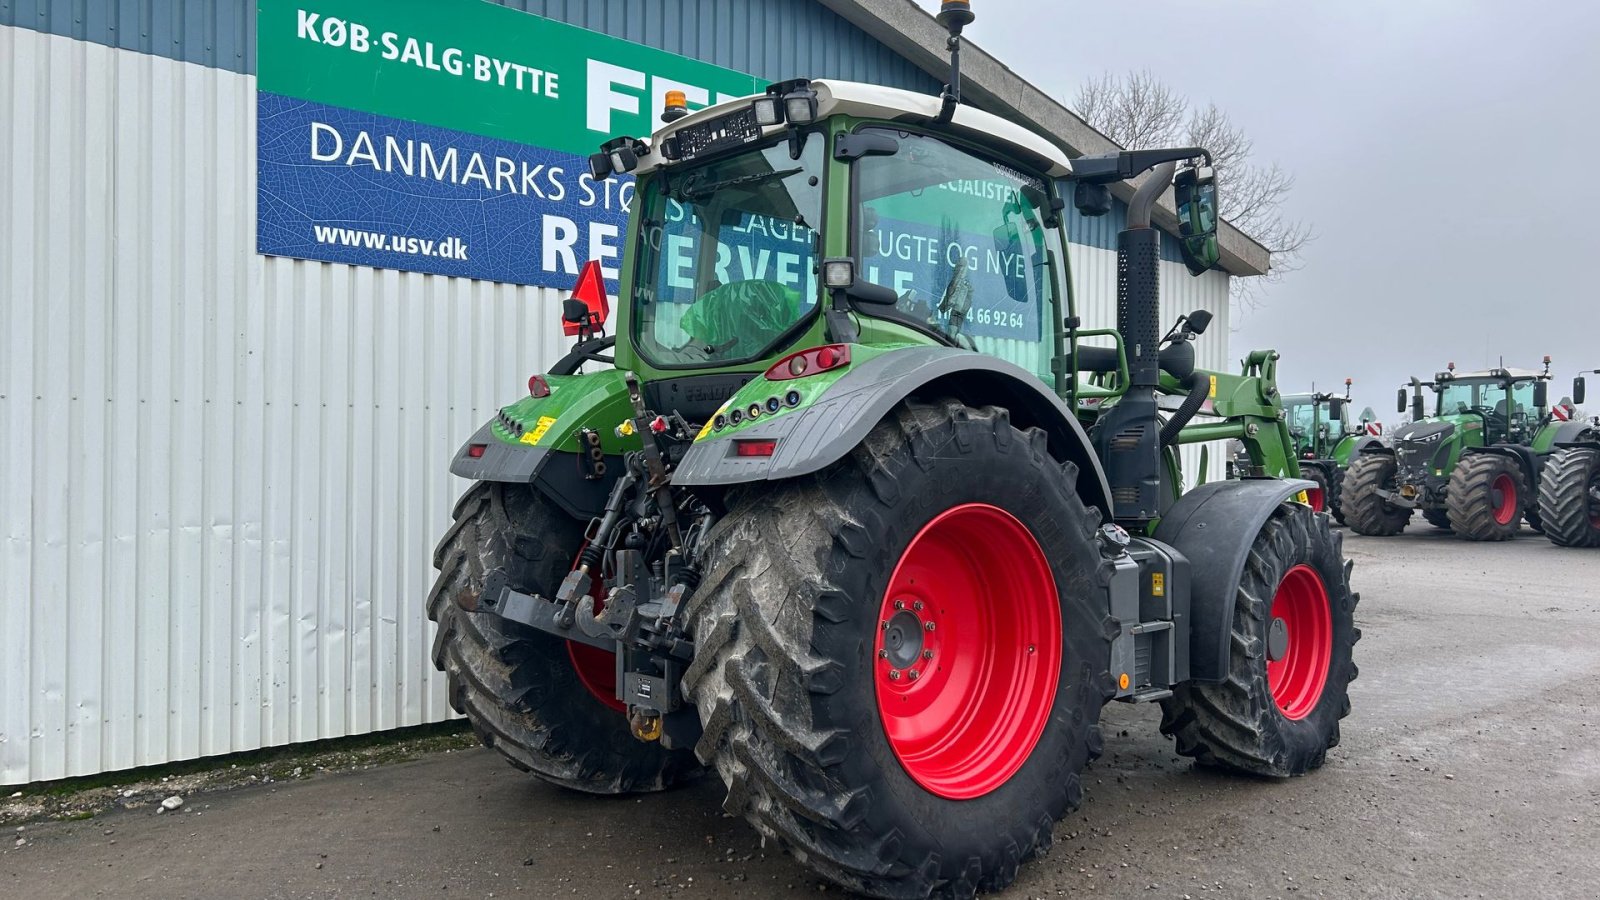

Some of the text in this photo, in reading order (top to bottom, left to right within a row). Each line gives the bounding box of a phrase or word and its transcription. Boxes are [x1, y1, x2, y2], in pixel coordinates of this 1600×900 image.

[312, 121, 565, 201] DANMARKS
[946, 241, 978, 272] OG
[986, 250, 1026, 279] NYE
[314, 226, 468, 261] www.usv.dk
[977, 308, 991, 325] 66
[993, 310, 1008, 327] 92
[1009, 312, 1024, 329] 64
